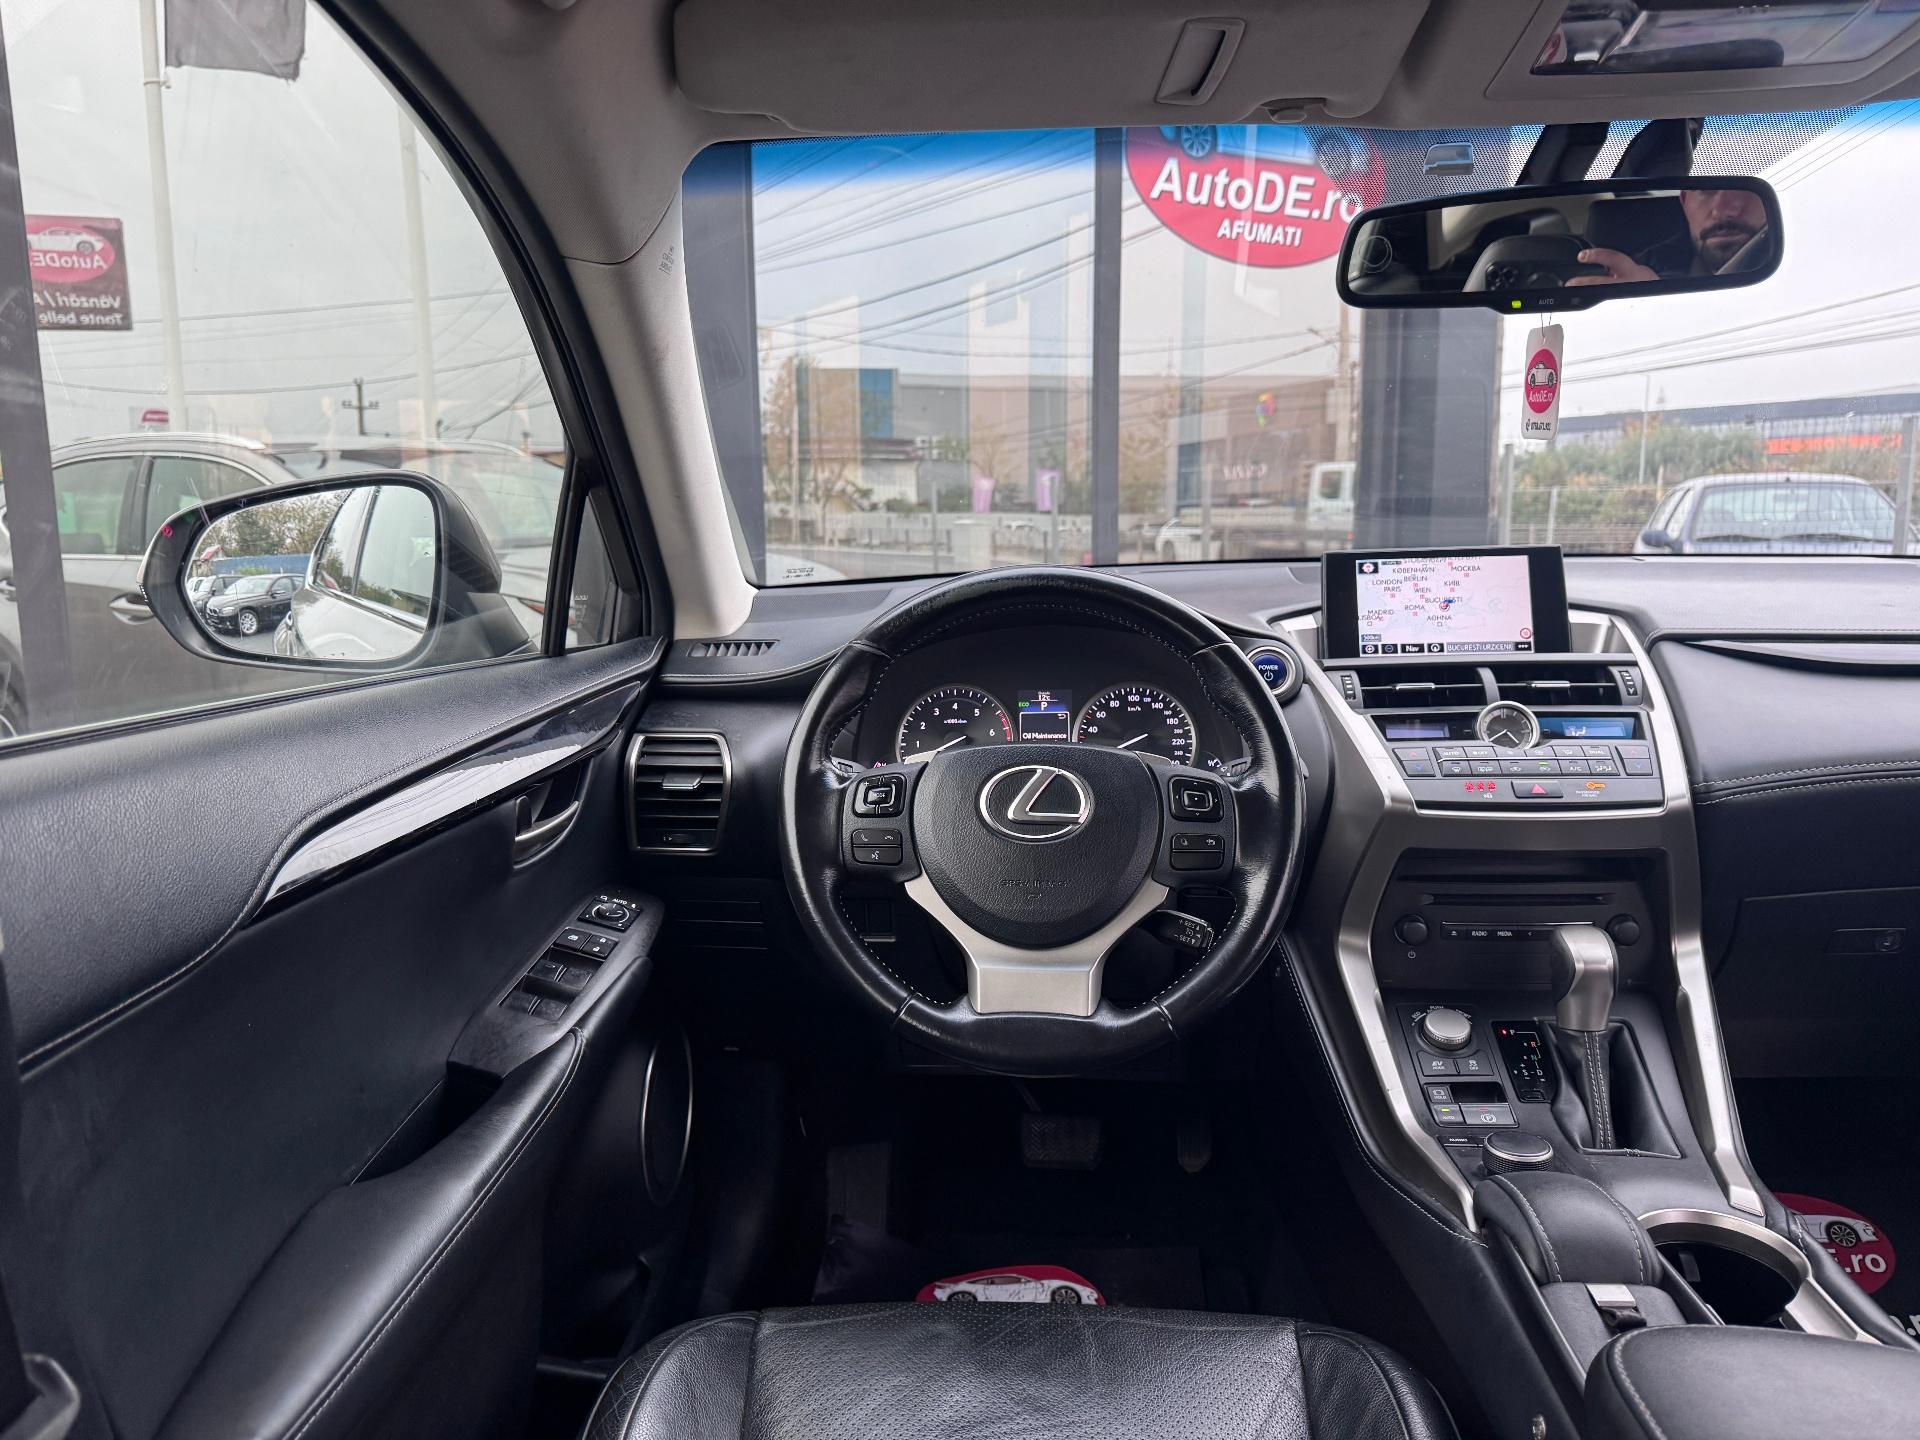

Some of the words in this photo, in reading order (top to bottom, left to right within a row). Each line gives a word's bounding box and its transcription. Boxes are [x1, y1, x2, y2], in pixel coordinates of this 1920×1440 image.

[1150, 157, 1363, 223] AutoDE.ro
[1217, 219, 1301, 247] AFUMATI
[952, 702, 958, 710] 4
[1041, 702, 1048, 711] P
[1109, 700, 1120, 708] 80
[933, 707, 940, 716] 3
[974, 708, 980, 717] 5
[1096, 711, 1107, 719] 60
[920, 721, 926, 730] 2
[989, 728, 996, 737] 6
